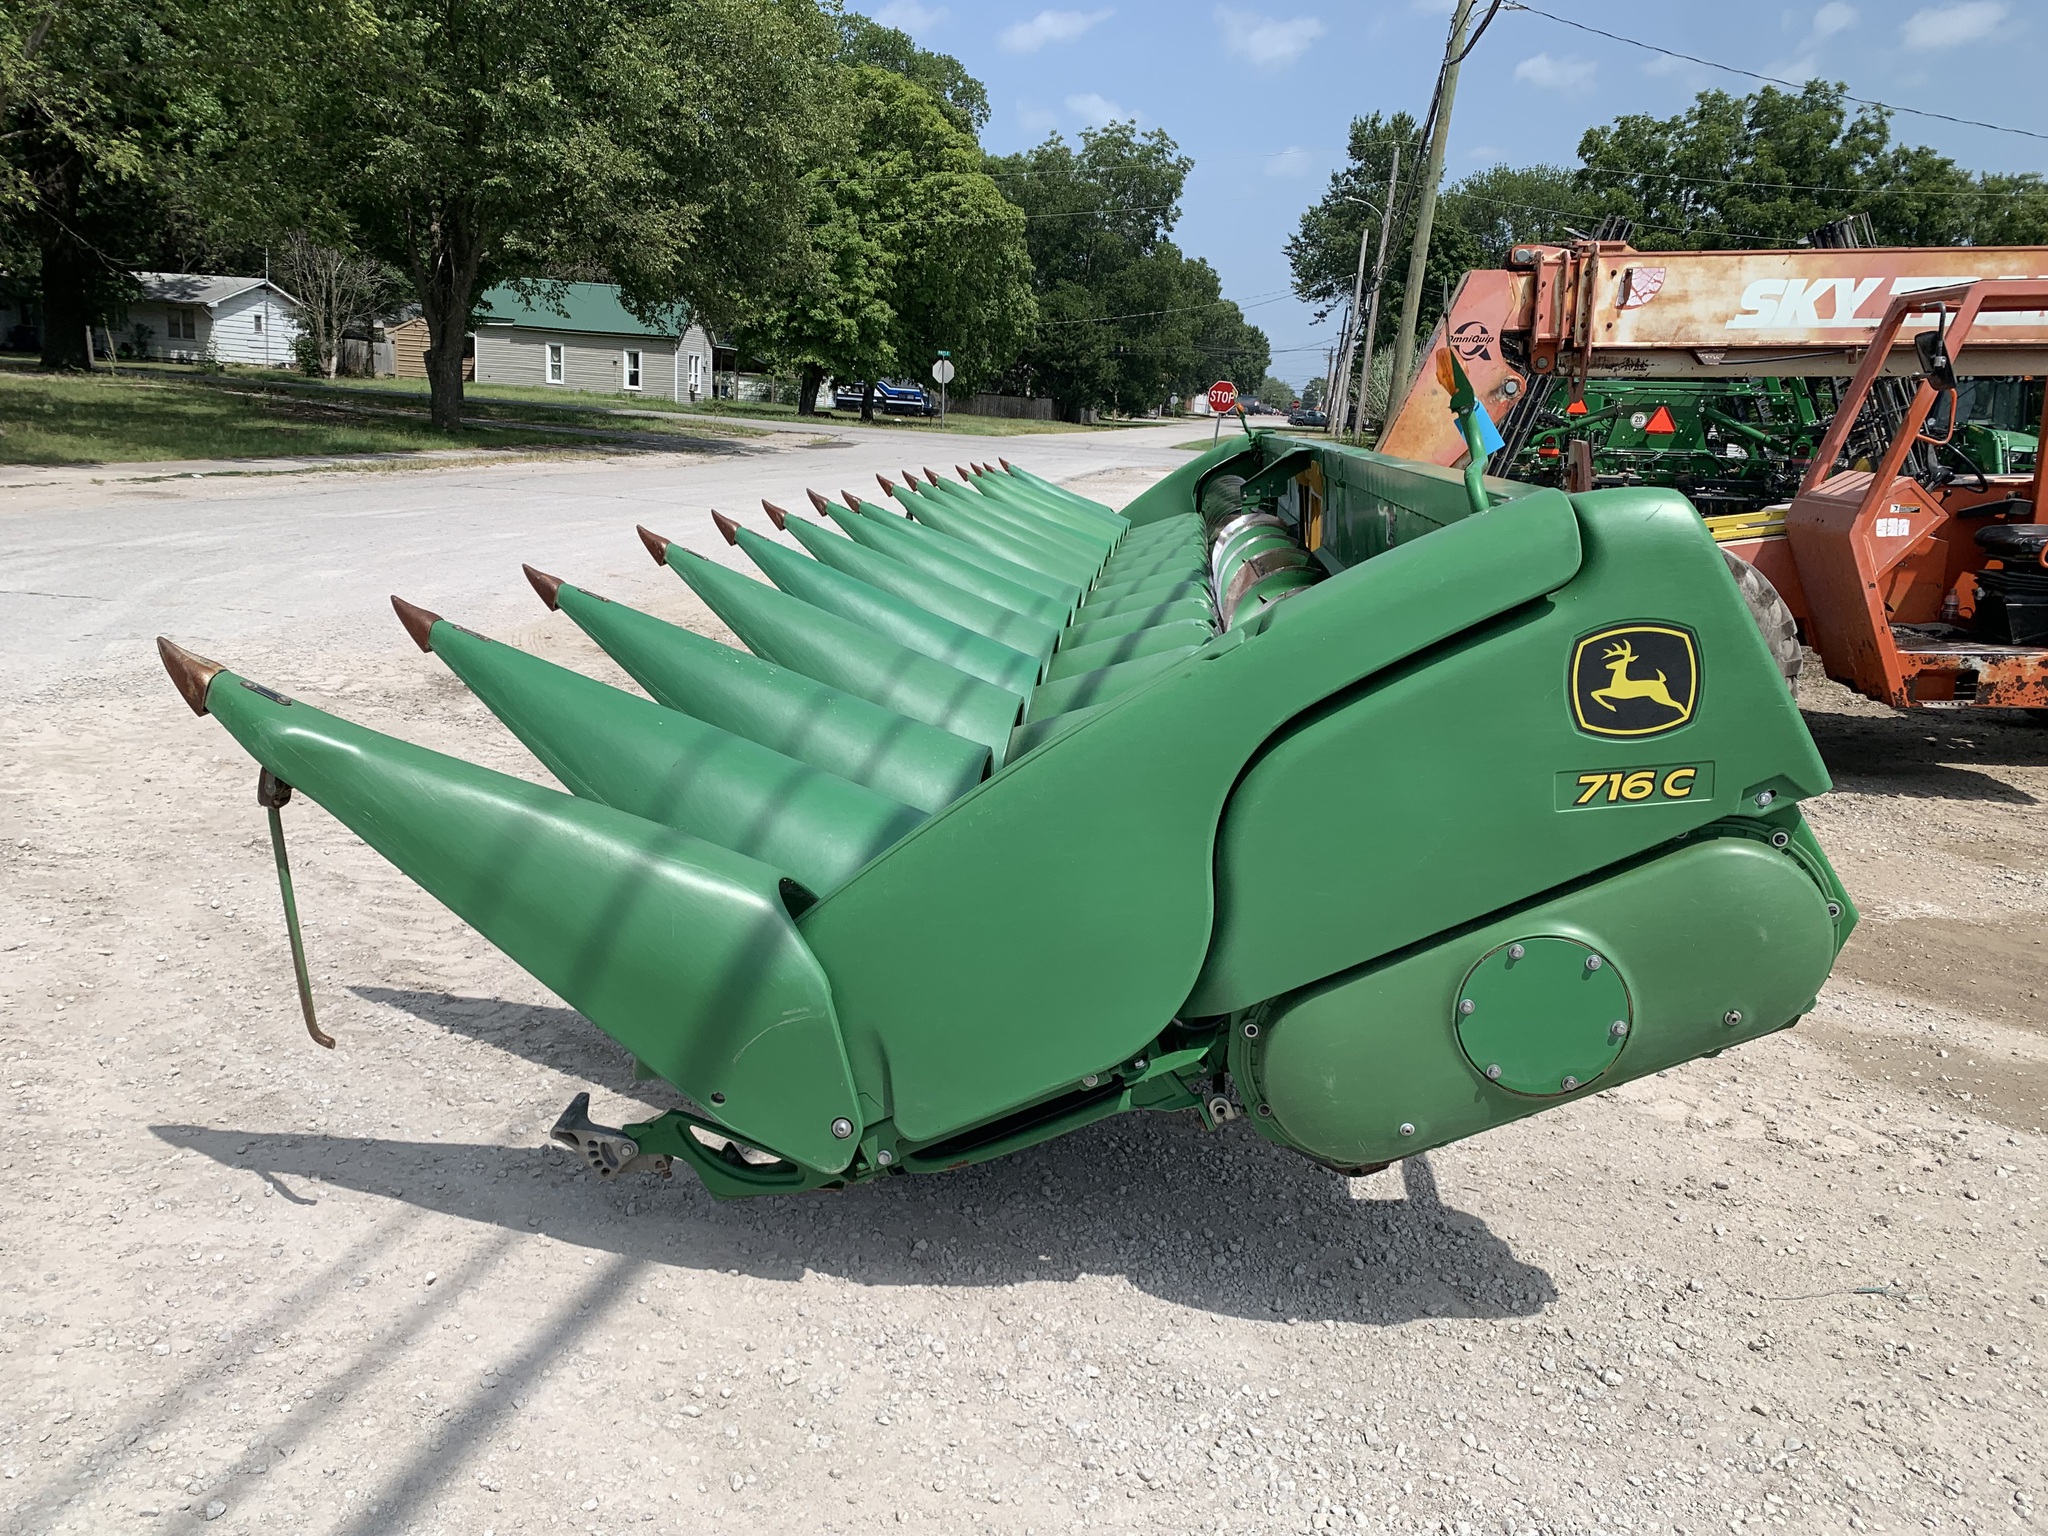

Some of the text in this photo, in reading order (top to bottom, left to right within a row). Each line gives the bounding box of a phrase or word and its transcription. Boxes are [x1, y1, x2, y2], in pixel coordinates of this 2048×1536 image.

[1210, 390, 1235, 404] STOP
[1574, 767, 1697, 805] 716 C
